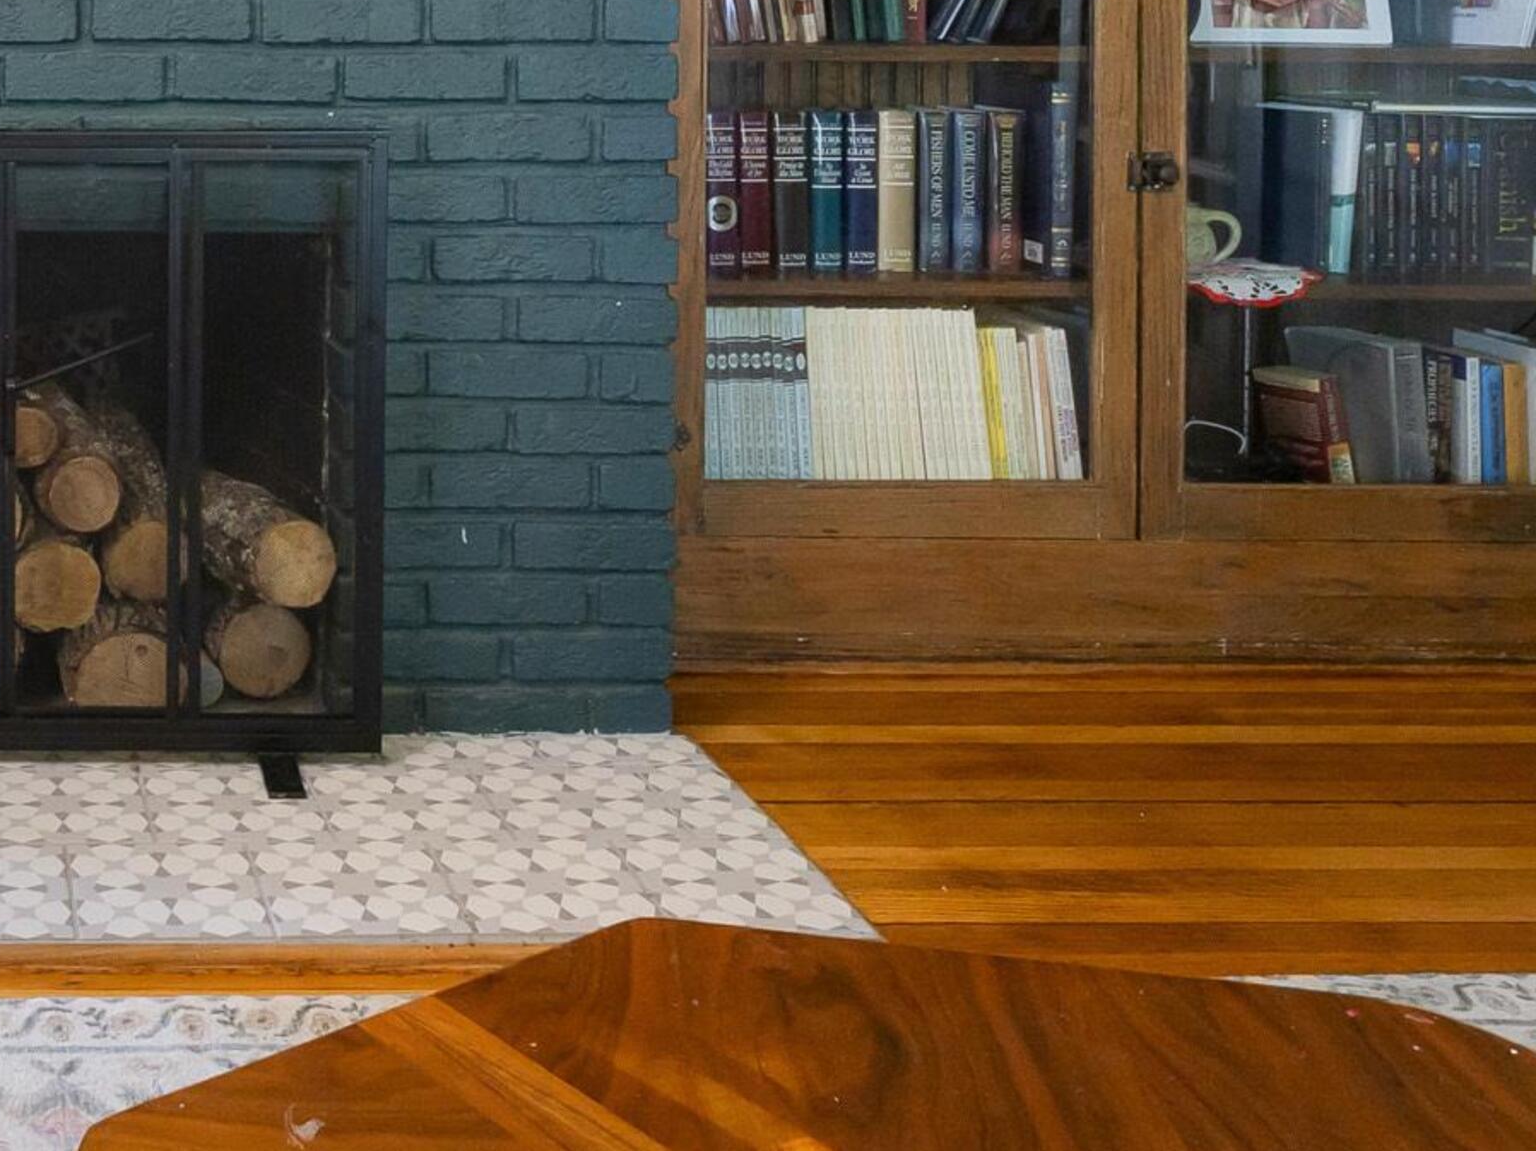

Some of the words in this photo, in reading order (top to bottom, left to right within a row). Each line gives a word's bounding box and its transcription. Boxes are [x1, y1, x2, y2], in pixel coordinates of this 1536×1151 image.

[930, 130, 944, 175] FISHERS
[963, 130, 976, 165] COME
[931, 176, 944, 193] OF
[931, 194, 944, 219] MEN
[962, 200, 976, 218] ME
[1000, 196, 1013, 220] MAN
